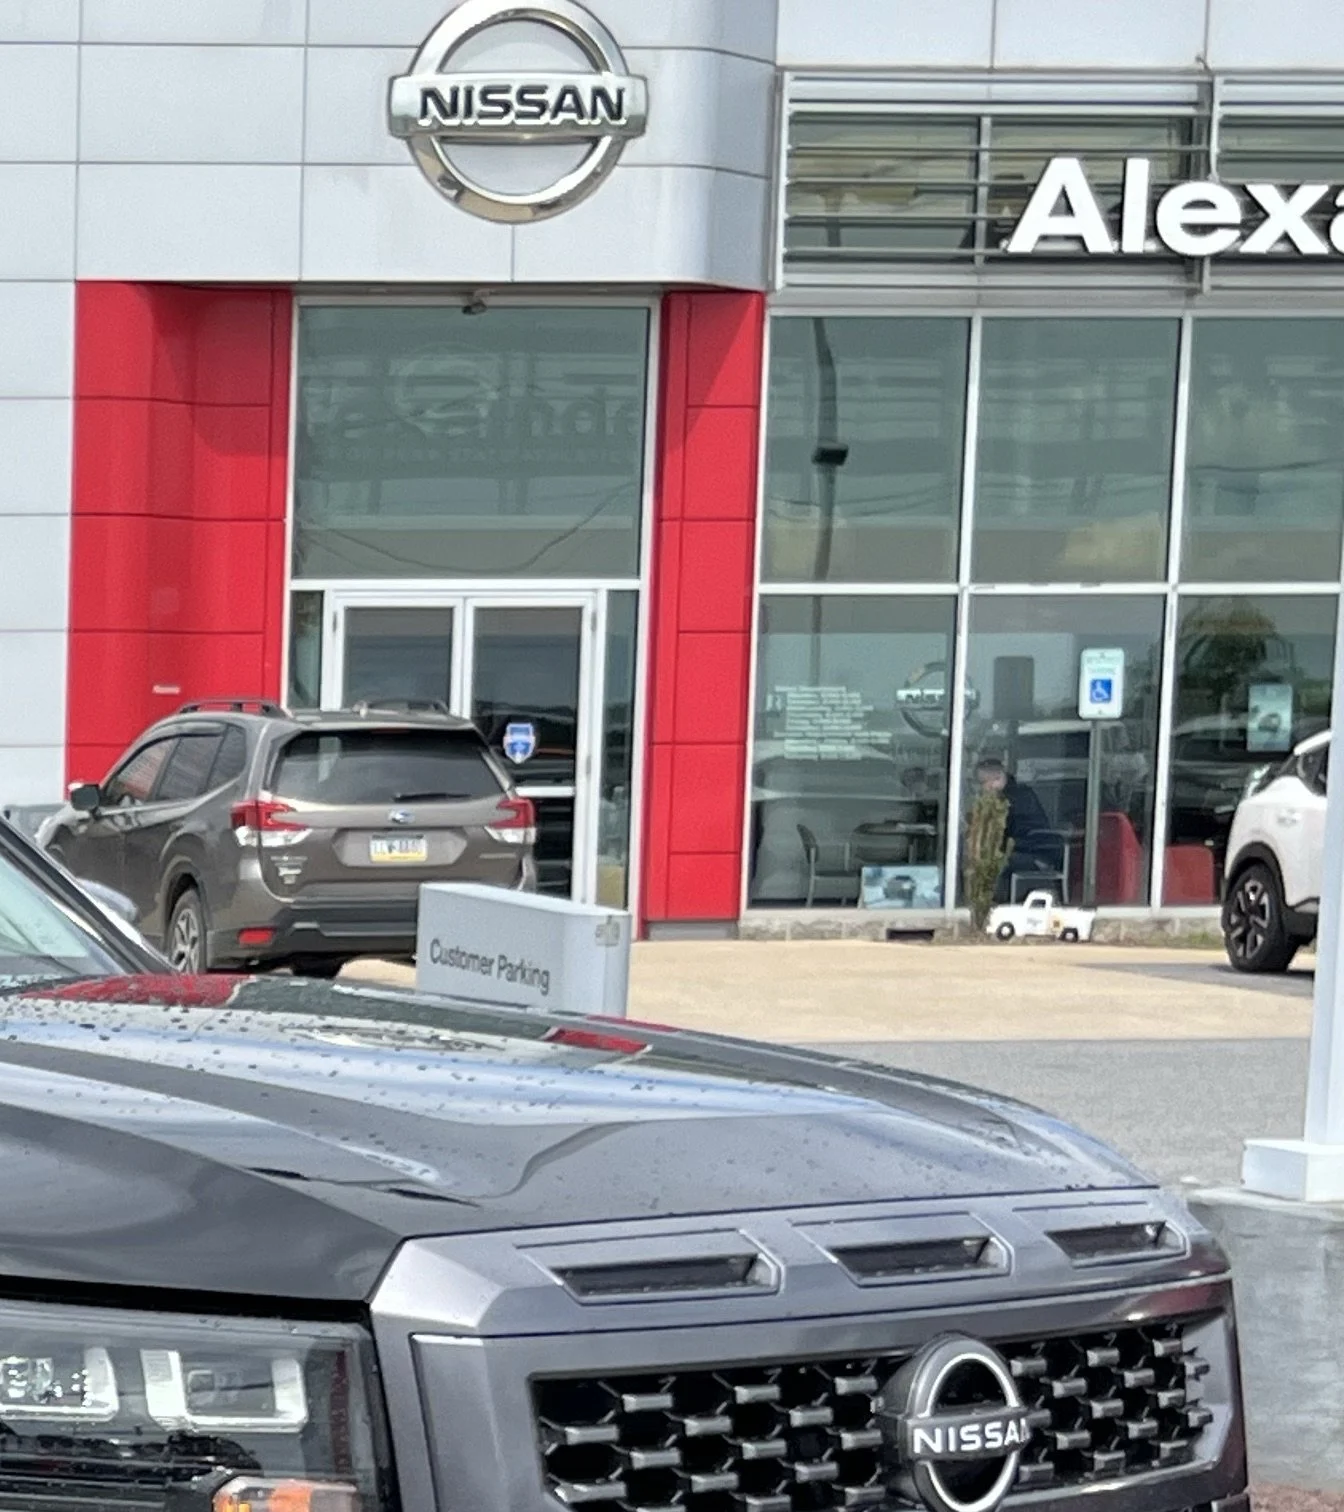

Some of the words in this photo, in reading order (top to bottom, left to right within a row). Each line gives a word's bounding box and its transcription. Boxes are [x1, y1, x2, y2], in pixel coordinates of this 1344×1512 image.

[418, 84, 625, 124] NISSAN
[1007, 157, 1344, 257] Alex
[430, 938, 494, 976] Customer
[497, 954, 551, 996] Parking
[913, 1417, 1031, 1455] NISSAN
